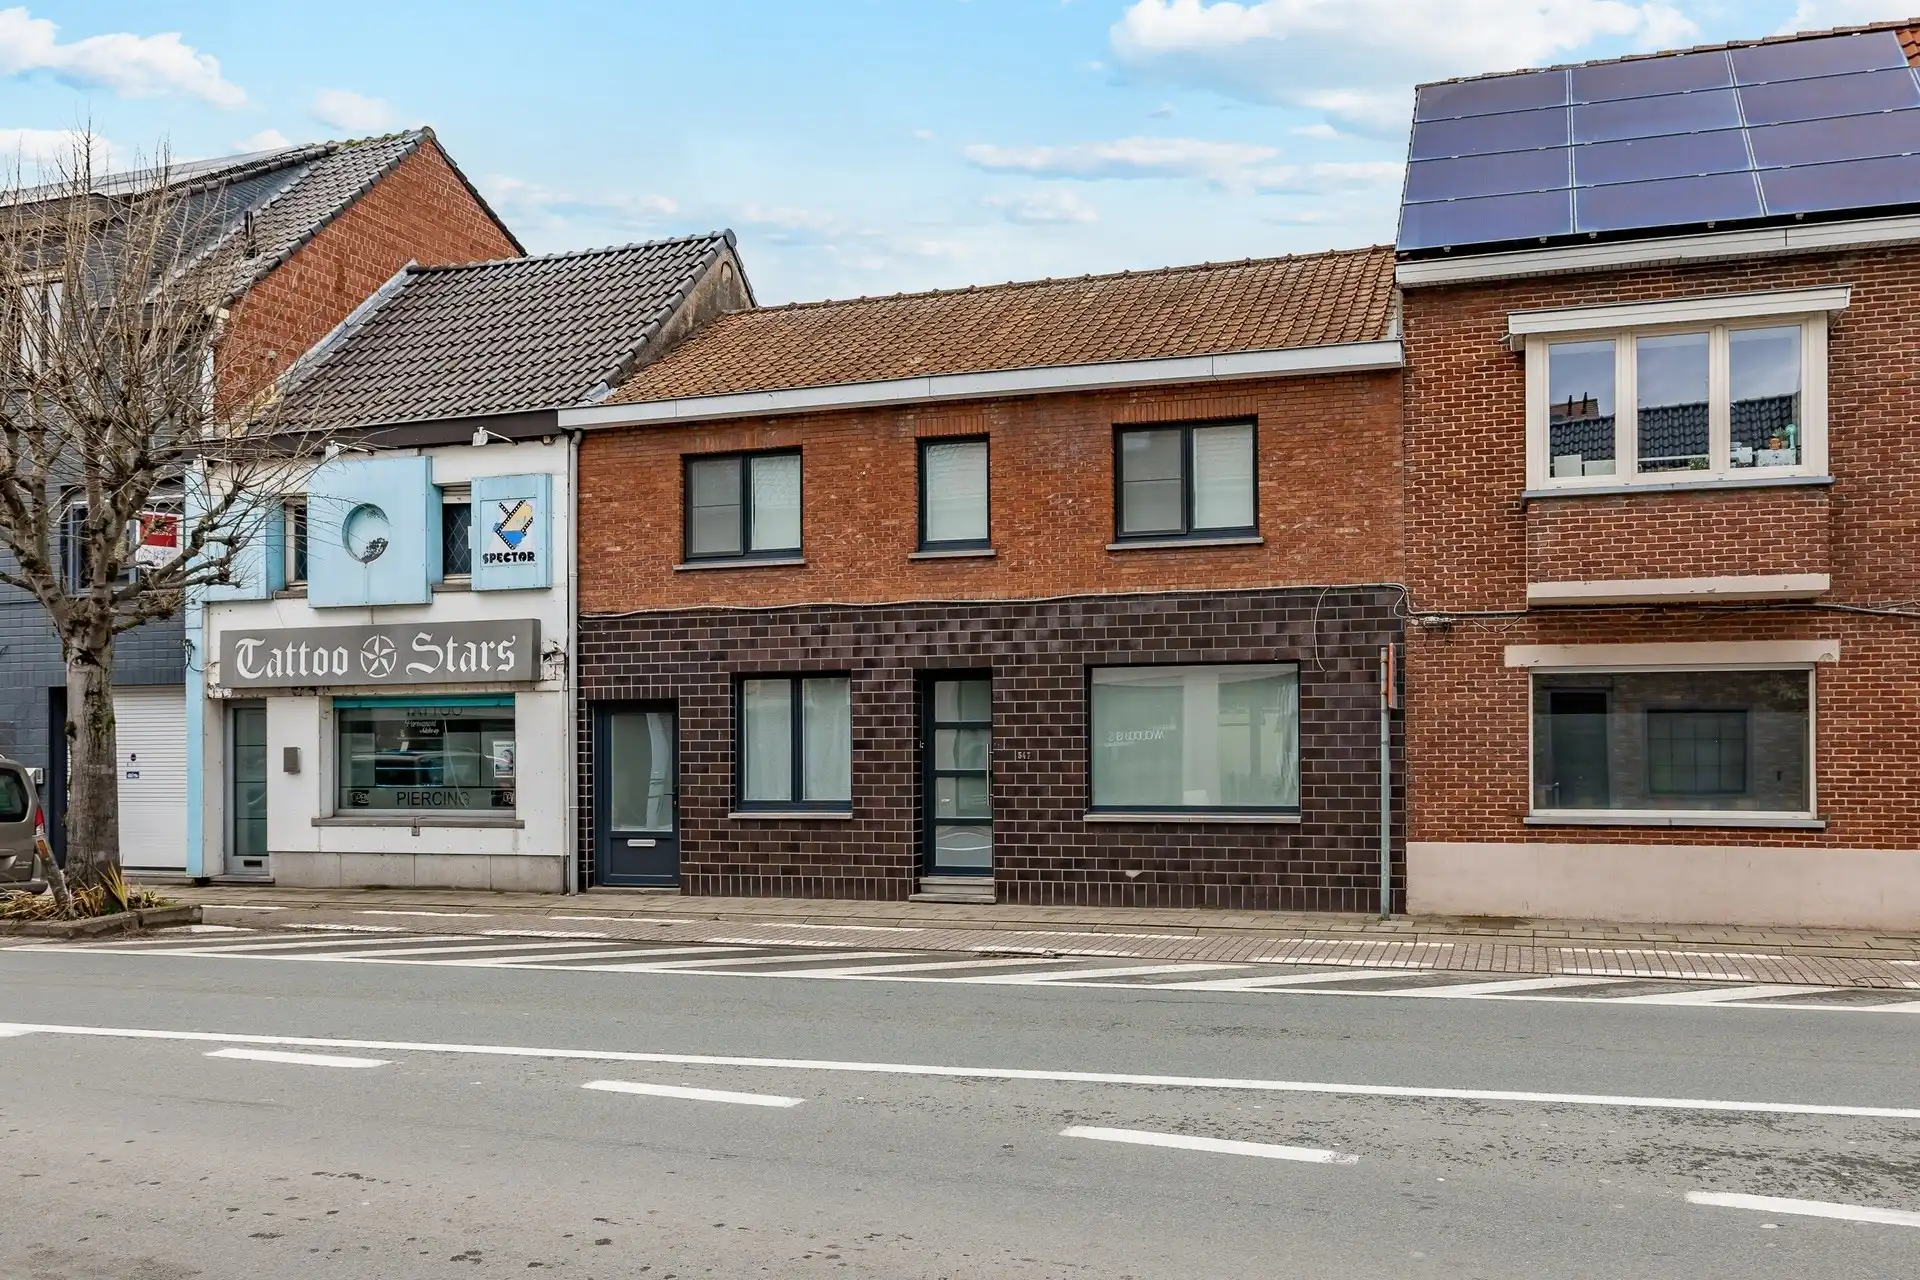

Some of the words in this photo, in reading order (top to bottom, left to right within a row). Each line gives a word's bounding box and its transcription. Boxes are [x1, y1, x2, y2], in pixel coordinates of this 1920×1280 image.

[482, 551, 536, 565] SPECTOR
[235, 637, 349, 679] Tattoo
[406, 631, 517, 675] Stars
[396, 791, 470, 806] PIERCING
